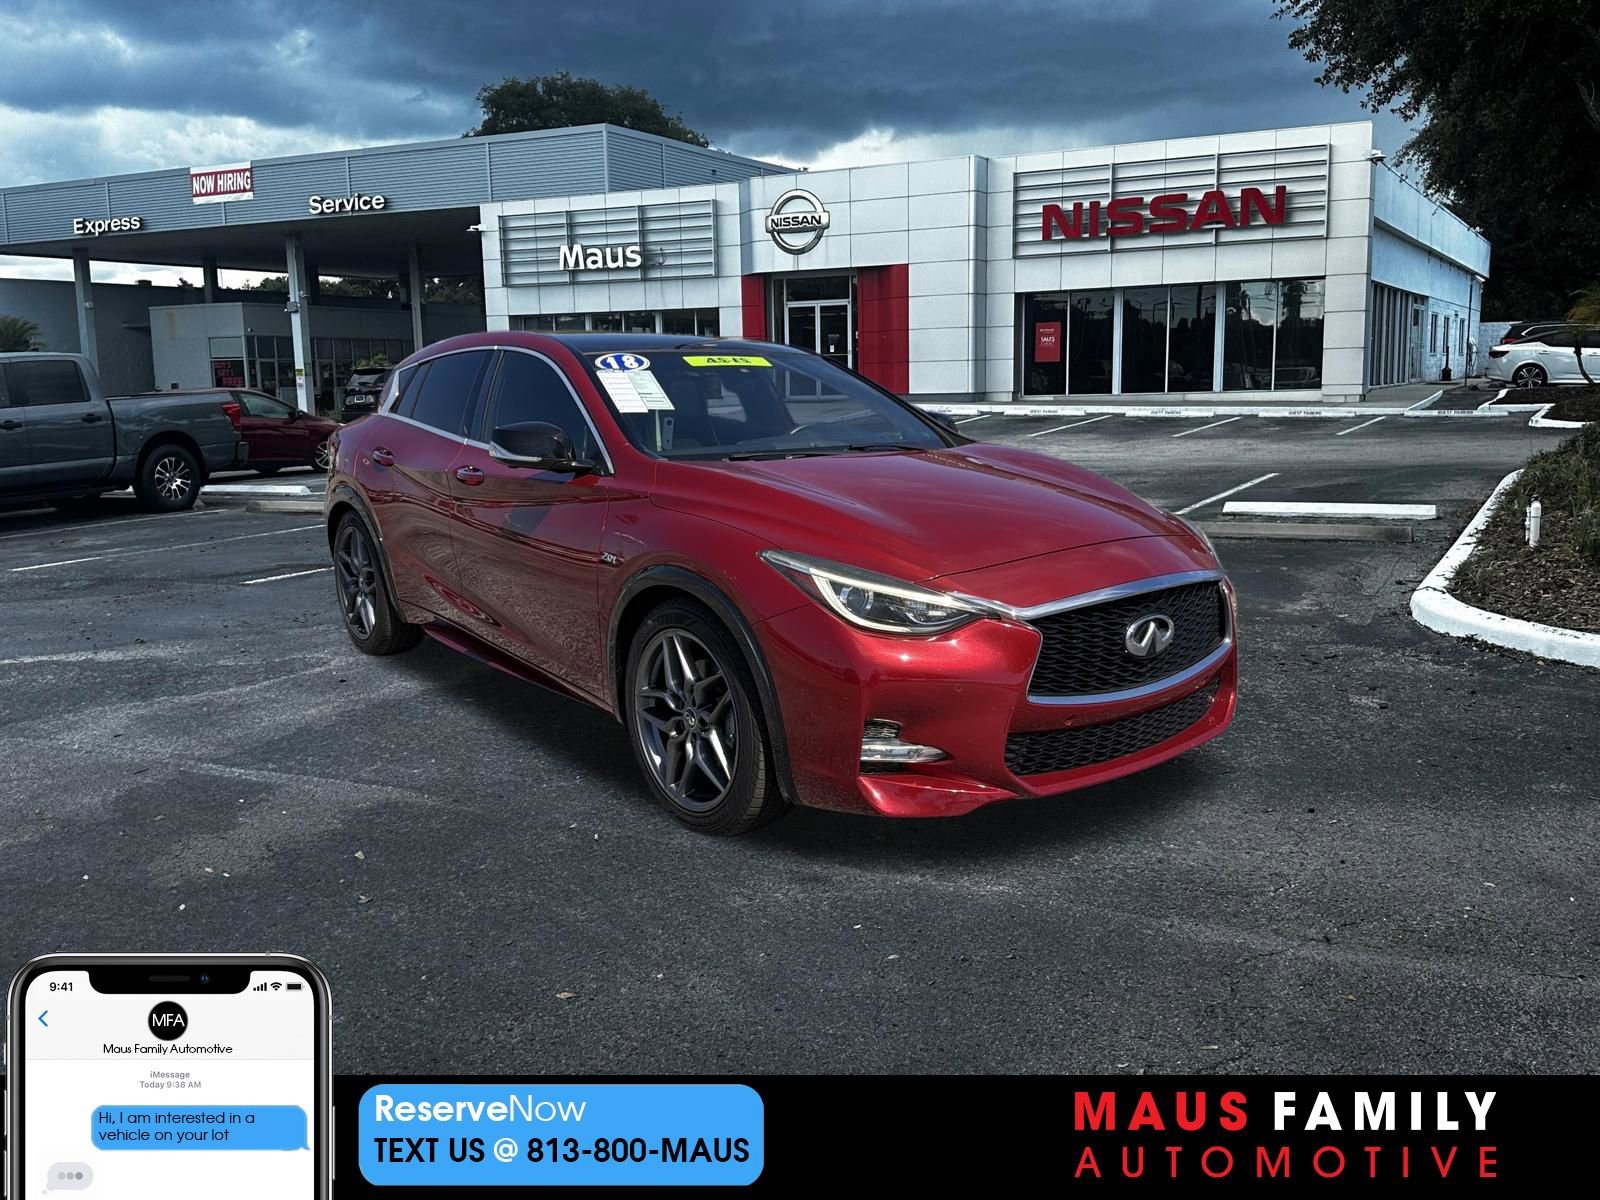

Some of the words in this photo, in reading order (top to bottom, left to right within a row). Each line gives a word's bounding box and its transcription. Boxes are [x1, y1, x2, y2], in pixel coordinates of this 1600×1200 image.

[192, 174, 215, 195] NOW
[217, 171, 251, 193] HIRING
[309, 193, 385, 214] Service
[1041, 185, 1287, 241] NISSAN
[73, 216, 141, 236] Express
[770, 214, 823, 228] NISSAN
[558, 243, 642, 271] Maus
[606, 355, 639, 369] 18
